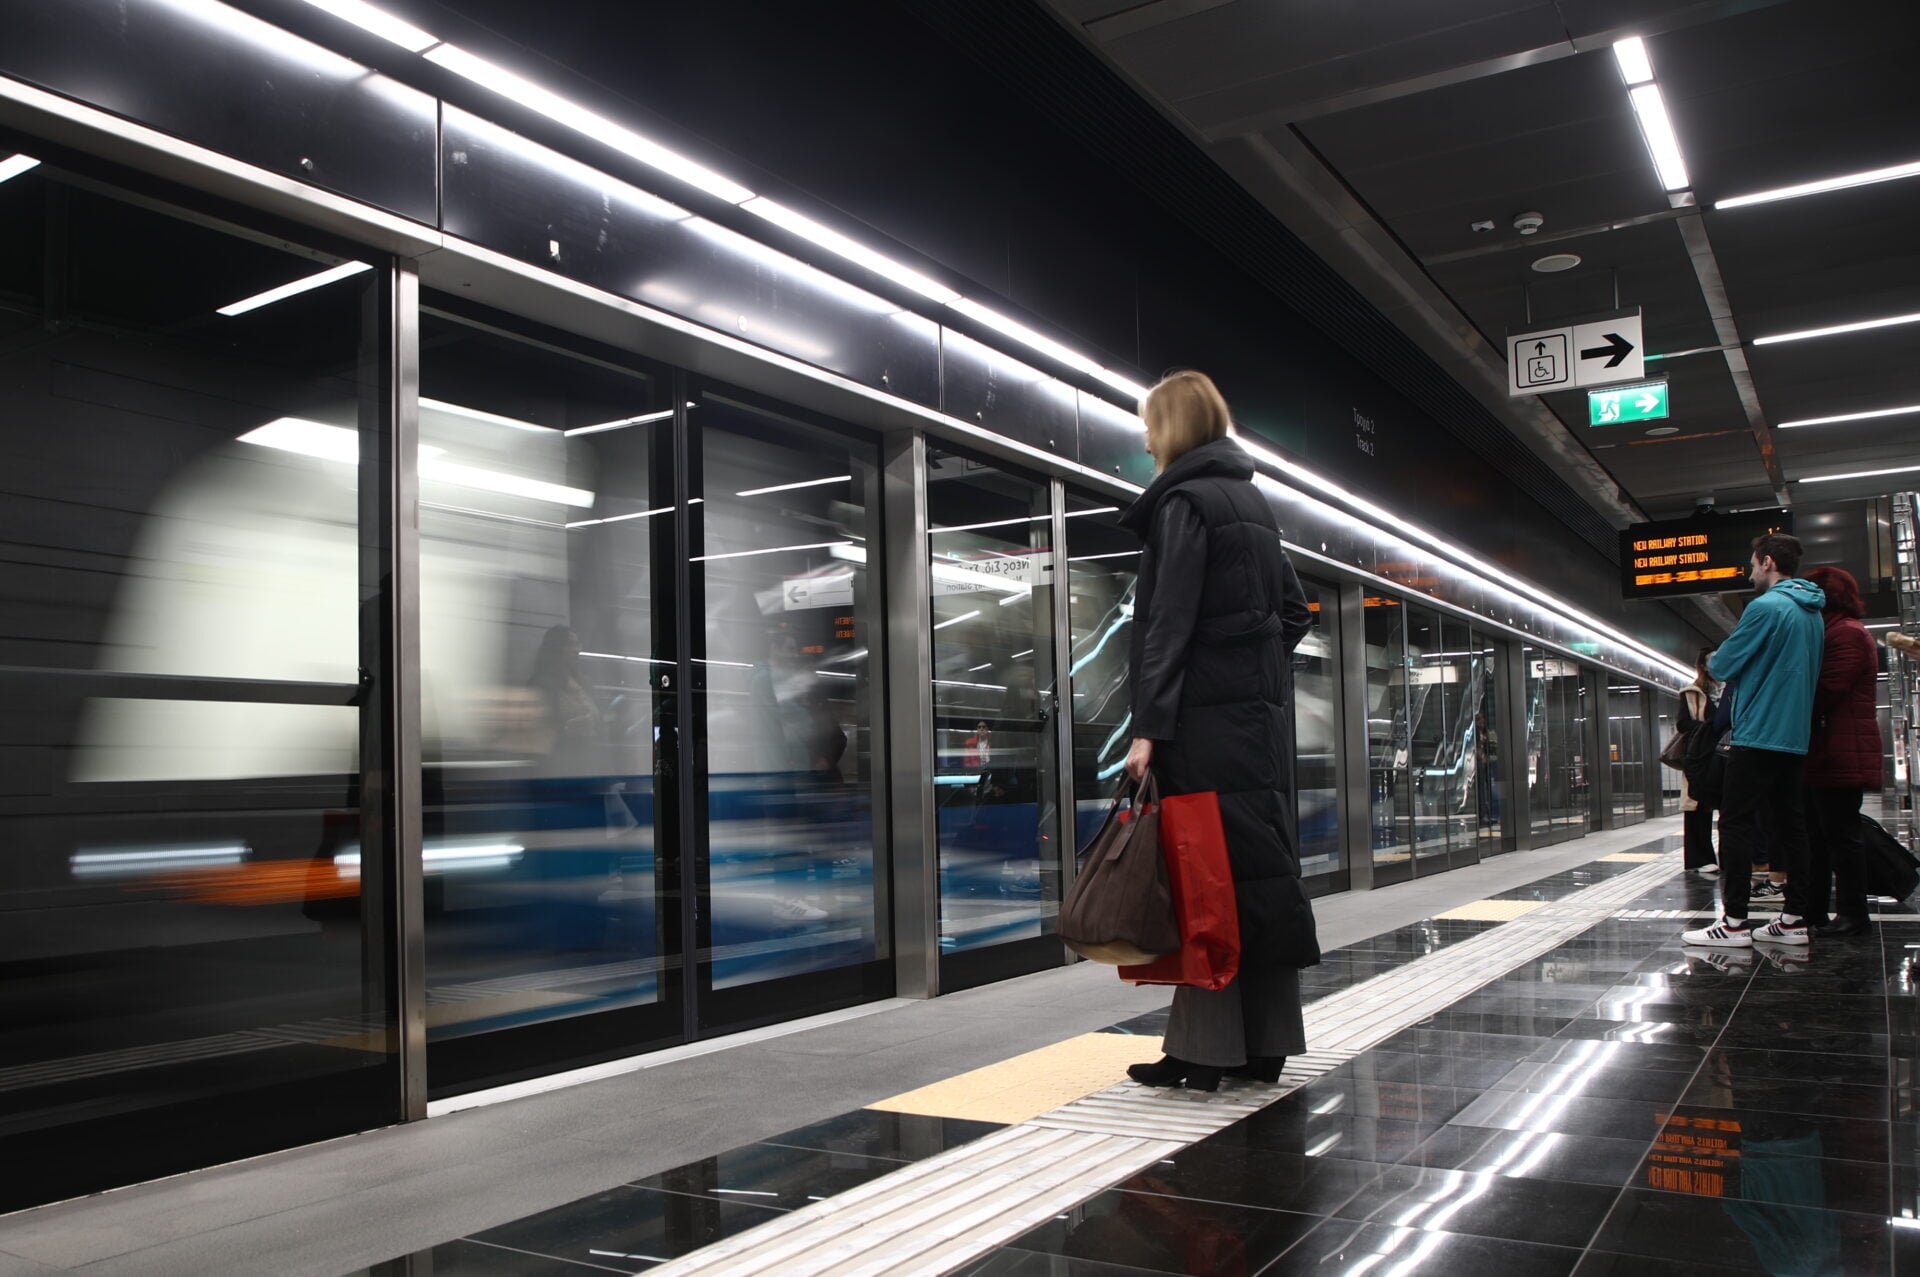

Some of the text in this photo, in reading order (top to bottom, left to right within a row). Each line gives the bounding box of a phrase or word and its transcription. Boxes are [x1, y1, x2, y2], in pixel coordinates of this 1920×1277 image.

[1370, 420, 1376, 434] 2
[1356, 433, 1375, 457] Track 2
[1634, 534, 1708, 552] NEW RAILWAY STATION
[1635, 551, 1709, 569] NEW RAILWAY STATION
